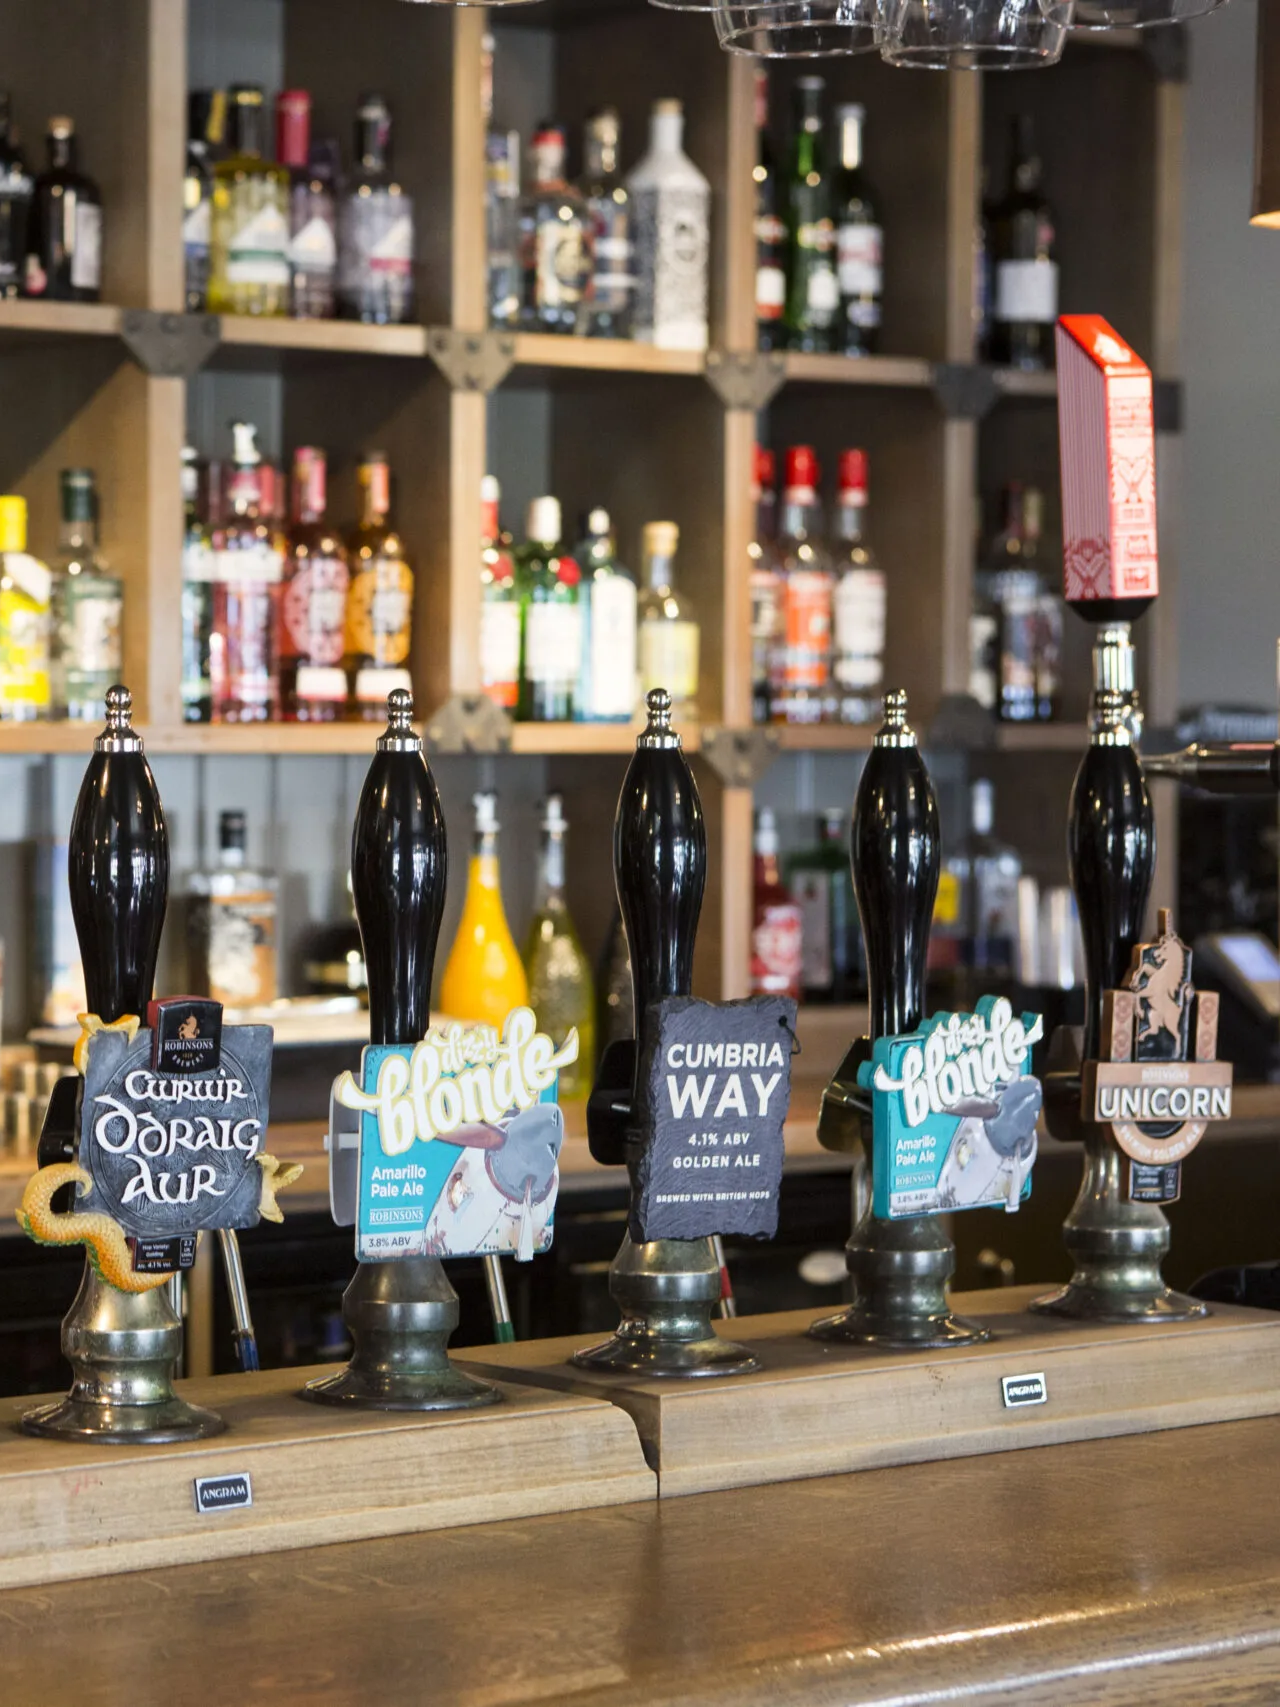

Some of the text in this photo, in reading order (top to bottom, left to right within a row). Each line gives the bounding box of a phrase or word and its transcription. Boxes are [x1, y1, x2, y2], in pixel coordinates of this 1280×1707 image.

[165, 1040, 214, 1051] ROBINSONS
[667, 1042, 785, 1068] CUMBRIA
[874, 997, 1043, 1128] blonde
[336, 1007, 579, 1156] blonde
[666, 1073, 783, 1119] WAY
[1099, 1087, 1231, 1118] UNICORN
[688, 1132, 750, 1147] 4.1% ABV
[896, 1134, 936, 1152] Amarillo
[672, 1154, 761, 1169] GOLDEN ALE
[896, 1149, 935, 1167] Pale Ale
[371, 1164, 427, 1181] Amarillo
[371, 1181, 424, 1198] Pale Ale
[656, 1190, 770, 1203] BREWED WITH BRITISH HOPS
[369, 1208, 424, 1224] ROBINSONS
[368, 1236, 411, 1248] 3.8% ABV
[202, 1485, 246, 1500] ANGRAM
